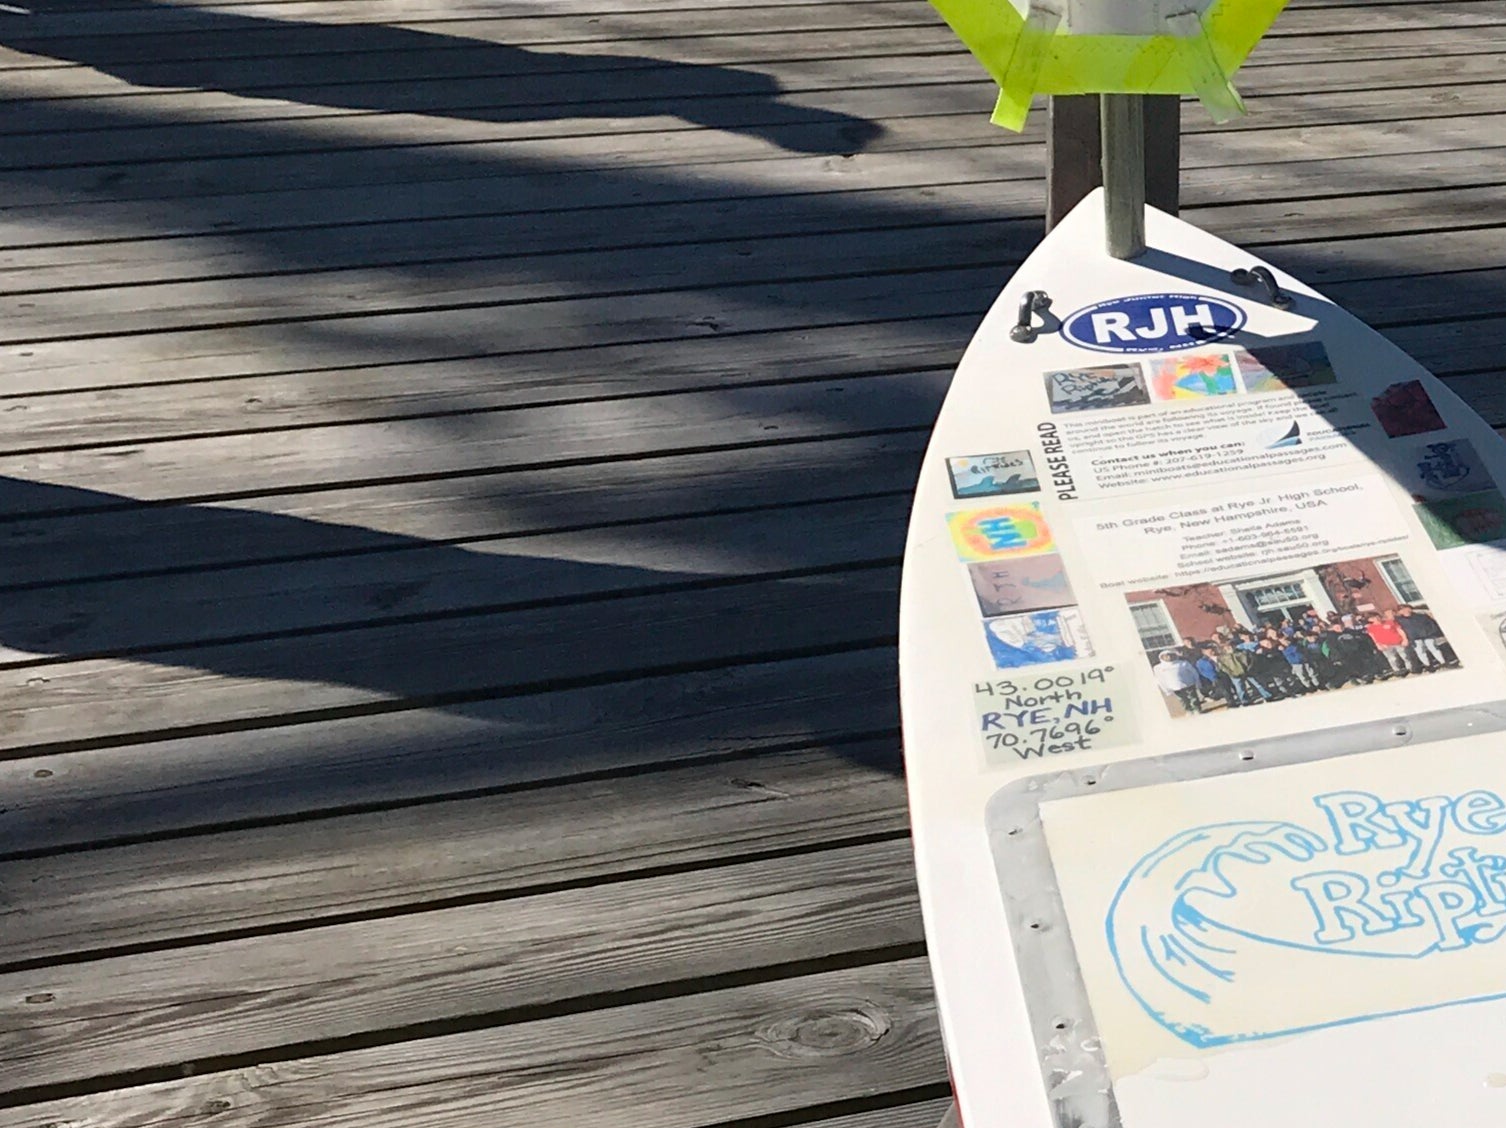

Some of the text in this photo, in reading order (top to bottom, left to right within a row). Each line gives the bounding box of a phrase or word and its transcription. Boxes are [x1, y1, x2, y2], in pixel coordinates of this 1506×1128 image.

[1092, 304, 1216, 344] RJH
[1037, 422, 1078, 500] PLEASE READ
[1092, 454, 1139, 466] Contact
[1142, 452, 1156, 460] us
[1158, 448, 1192, 458] when
[1194, 444, 1218, 454] you
[1112, 460, 1150, 472] Phone
[1166, 450, 1244, 464] 207-619-1259
[1096, 520, 1118, 530] 5th
[1122, 515, 1166, 527] Grade
[1168, 508, 1208, 520] Class
[1210, 504, 1224, 513] at
[1228, 500, 1255, 510] Rye
[1278, 491, 1310, 502] High
[1180, 519, 1210, 529] New
[1296, 500, 1328, 510] USA
[978, 517, 1028, 550] NH
[1266, 518, 1301, 529] Adams
[1006, 689, 1082, 710] North
[1064, 698, 1113, 718] NH
[1012, 736, 1092, 760] West
